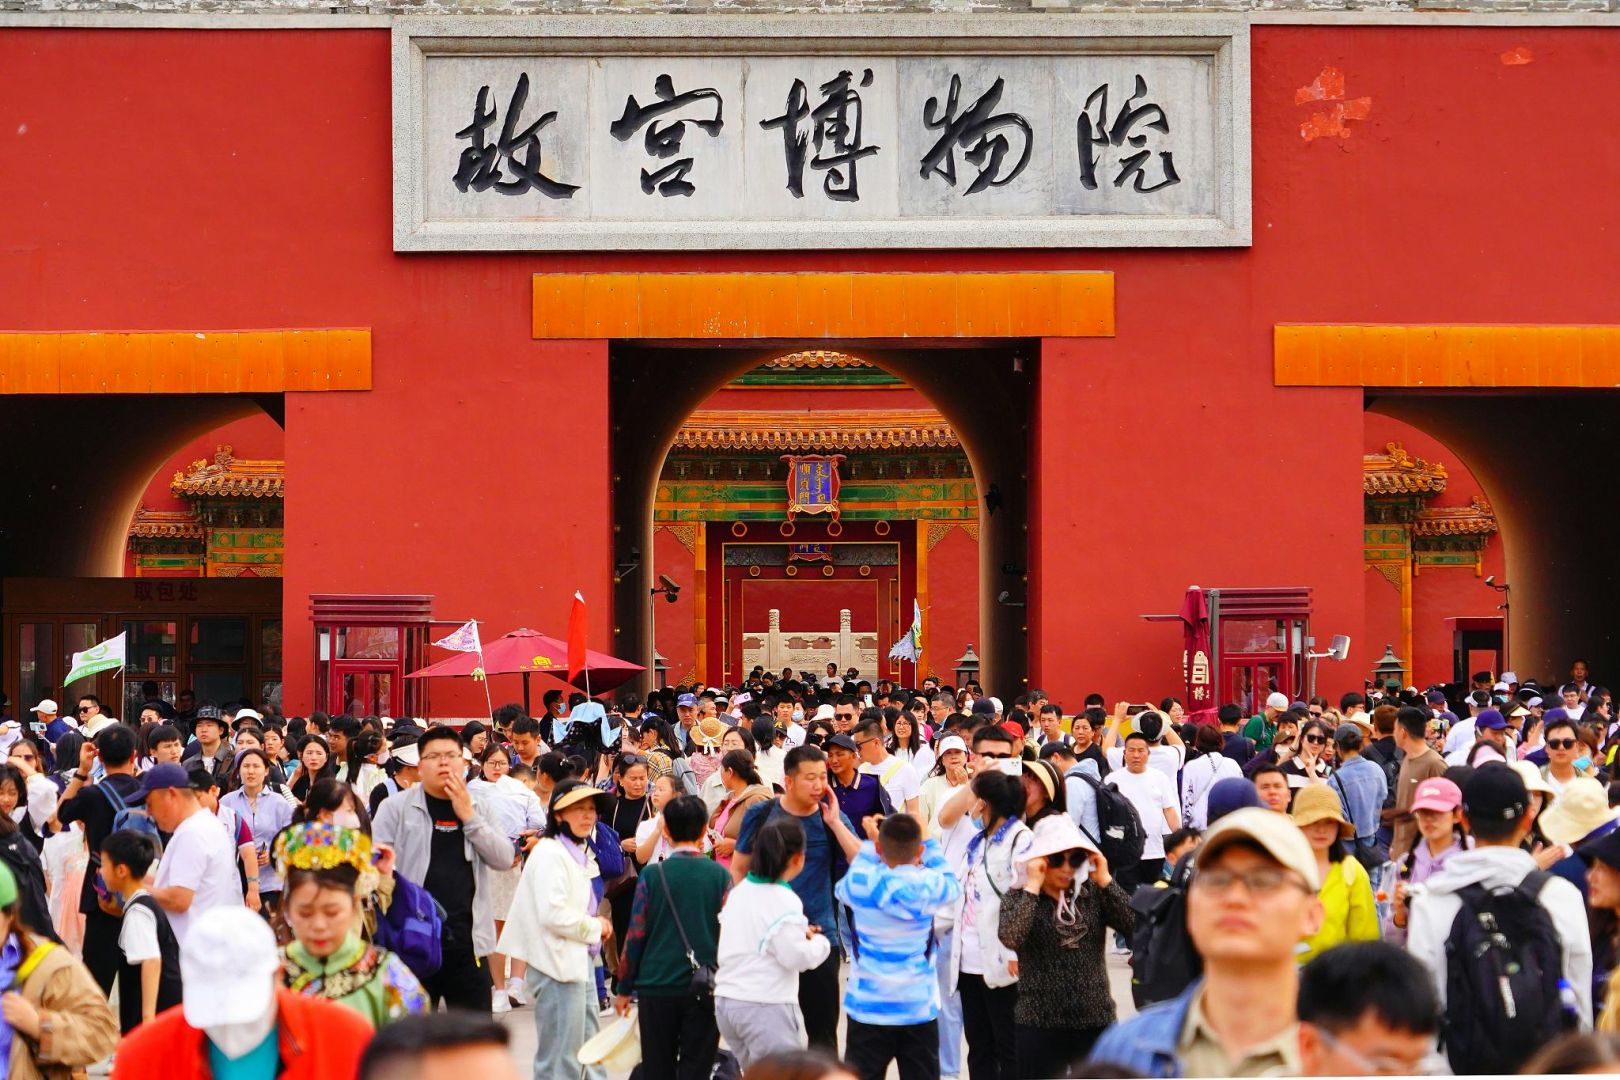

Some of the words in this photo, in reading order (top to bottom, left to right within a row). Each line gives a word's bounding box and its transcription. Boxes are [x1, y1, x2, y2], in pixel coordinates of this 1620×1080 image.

[453, 69, 1180, 200] 故宫博物院
[134, 581, 198, 601] 取包处
